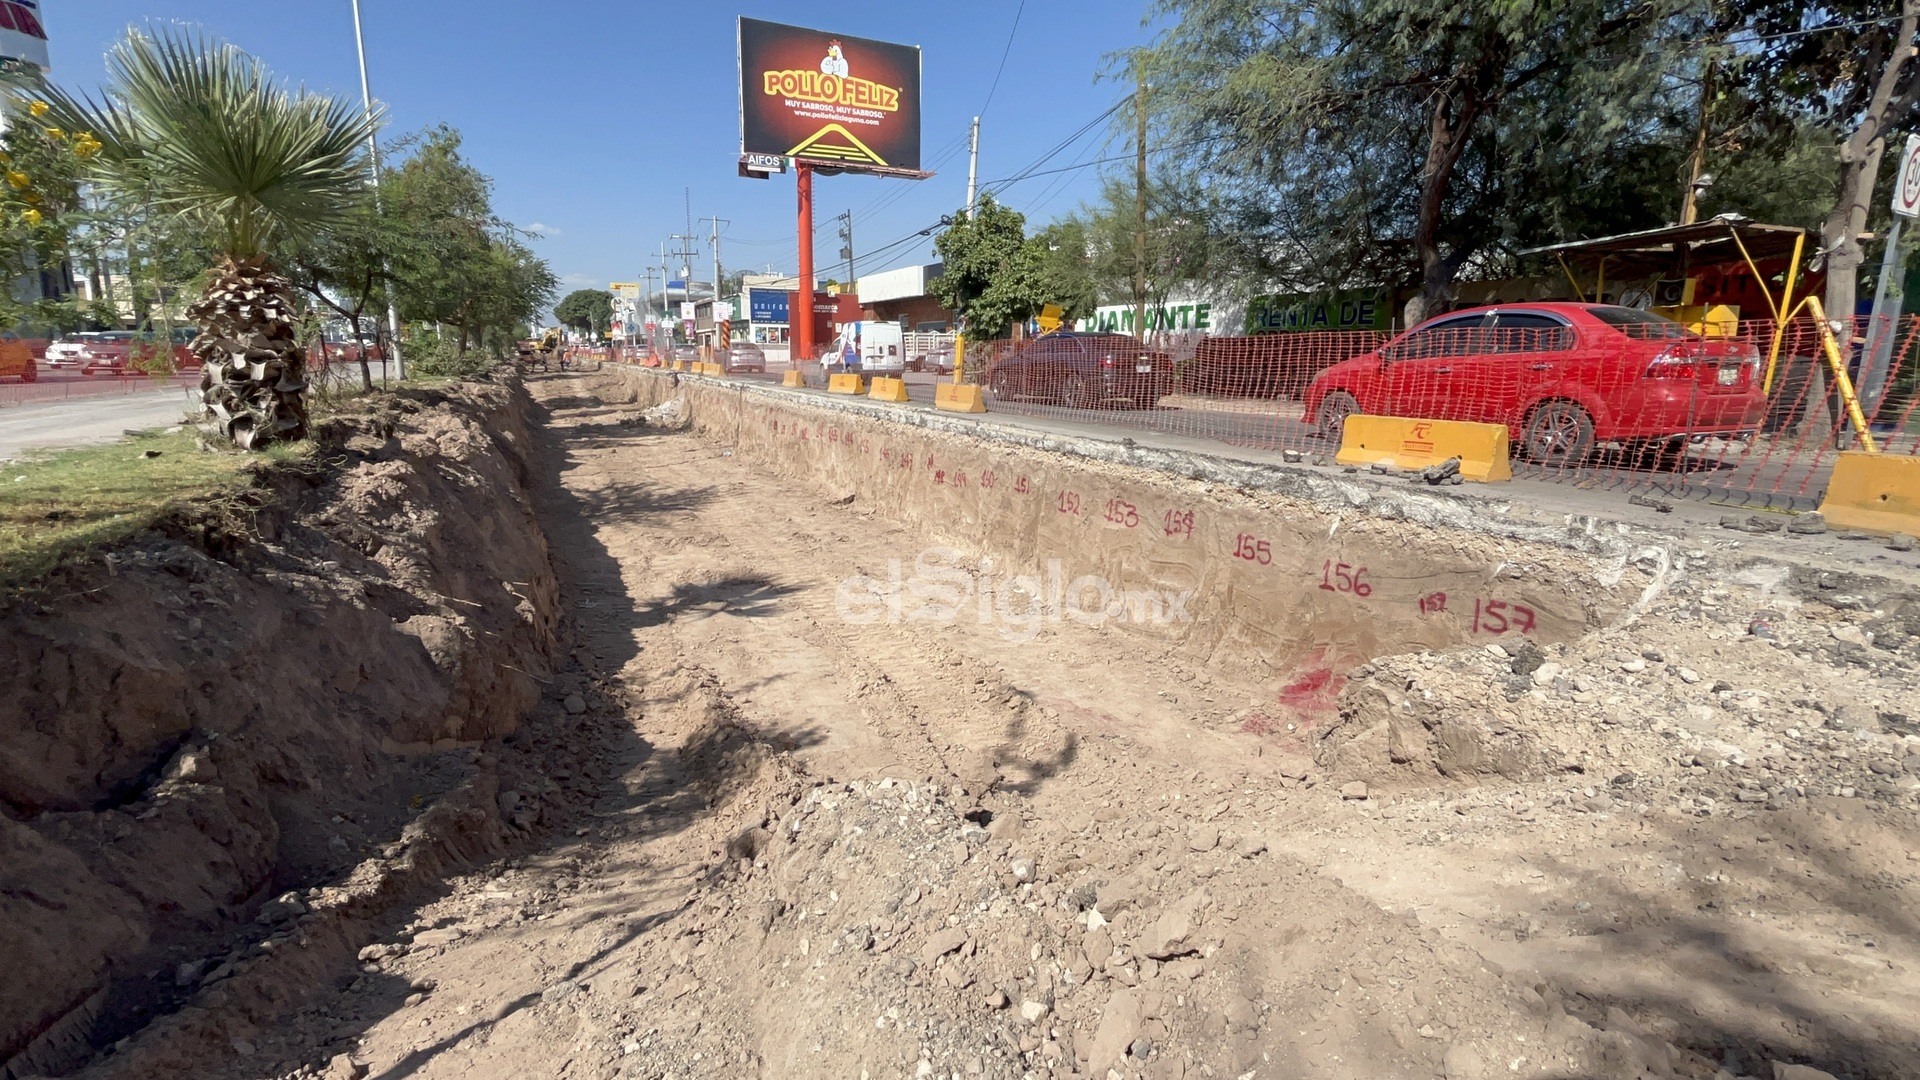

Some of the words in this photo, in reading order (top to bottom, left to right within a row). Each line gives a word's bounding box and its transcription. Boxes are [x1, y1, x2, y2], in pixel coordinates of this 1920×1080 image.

[764, 70, 840, 103] POLLO
[838, 76, 898, 111] FELIZ
[785, 99, 801, 108] MUY
[801, 102, 835, 113] SABROSO,
[836, 106, 851, 114] MUY
[748, 154, 780, 166] AIFOS
[1085, 304, 1211, 333] DIAMANTE
[1340, 301, 1376, 326] DE
[1014, 475, 1030, 494] 151
[1057, 490, 1080, 515] 152
[1104, 499, 1139, 528] 153
[1233, 533, 1272, 565] 155
[1318, 559, 1372, 597] 156
[1472, 598, 1537, 634] 157
